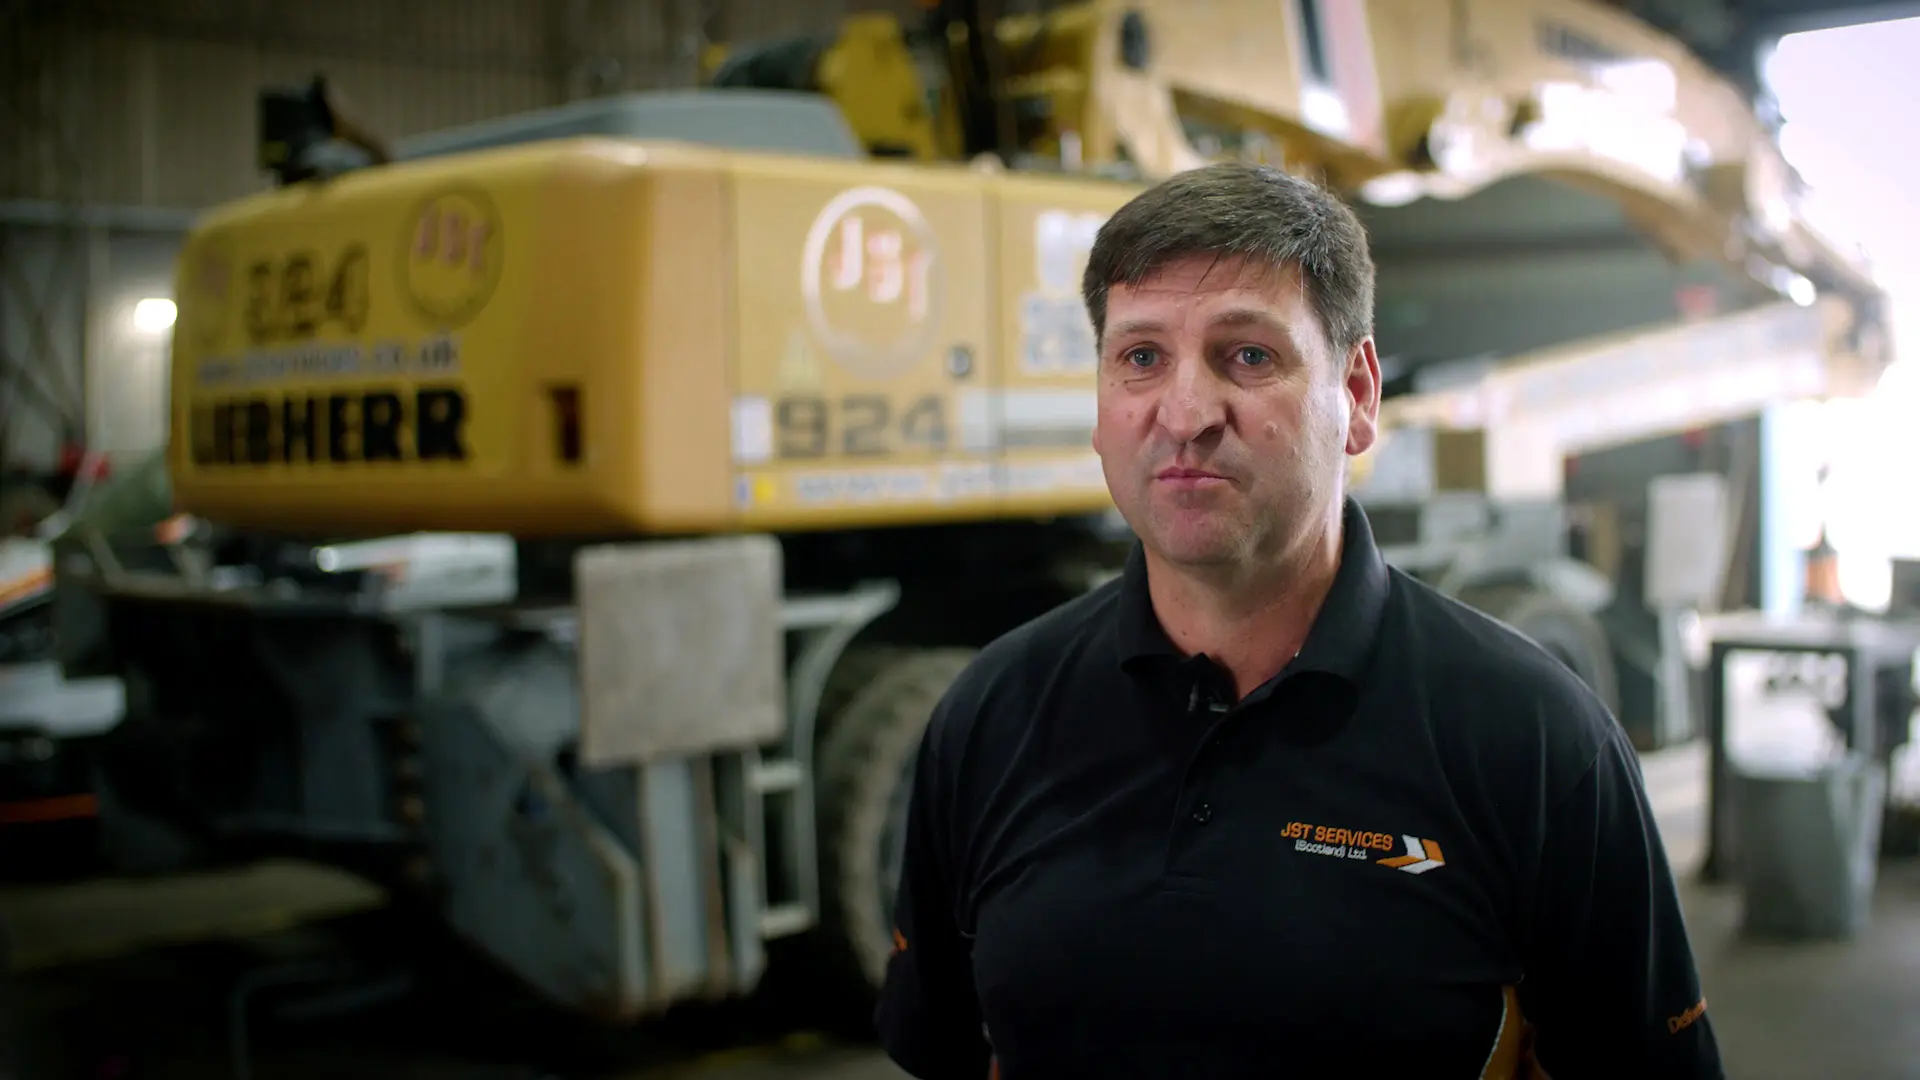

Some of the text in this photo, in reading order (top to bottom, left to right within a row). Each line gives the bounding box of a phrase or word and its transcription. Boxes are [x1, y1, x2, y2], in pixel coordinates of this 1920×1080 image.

[776, 393, 948, 460] 924
[1280, 821, 1393, 851] JST SERVICES
